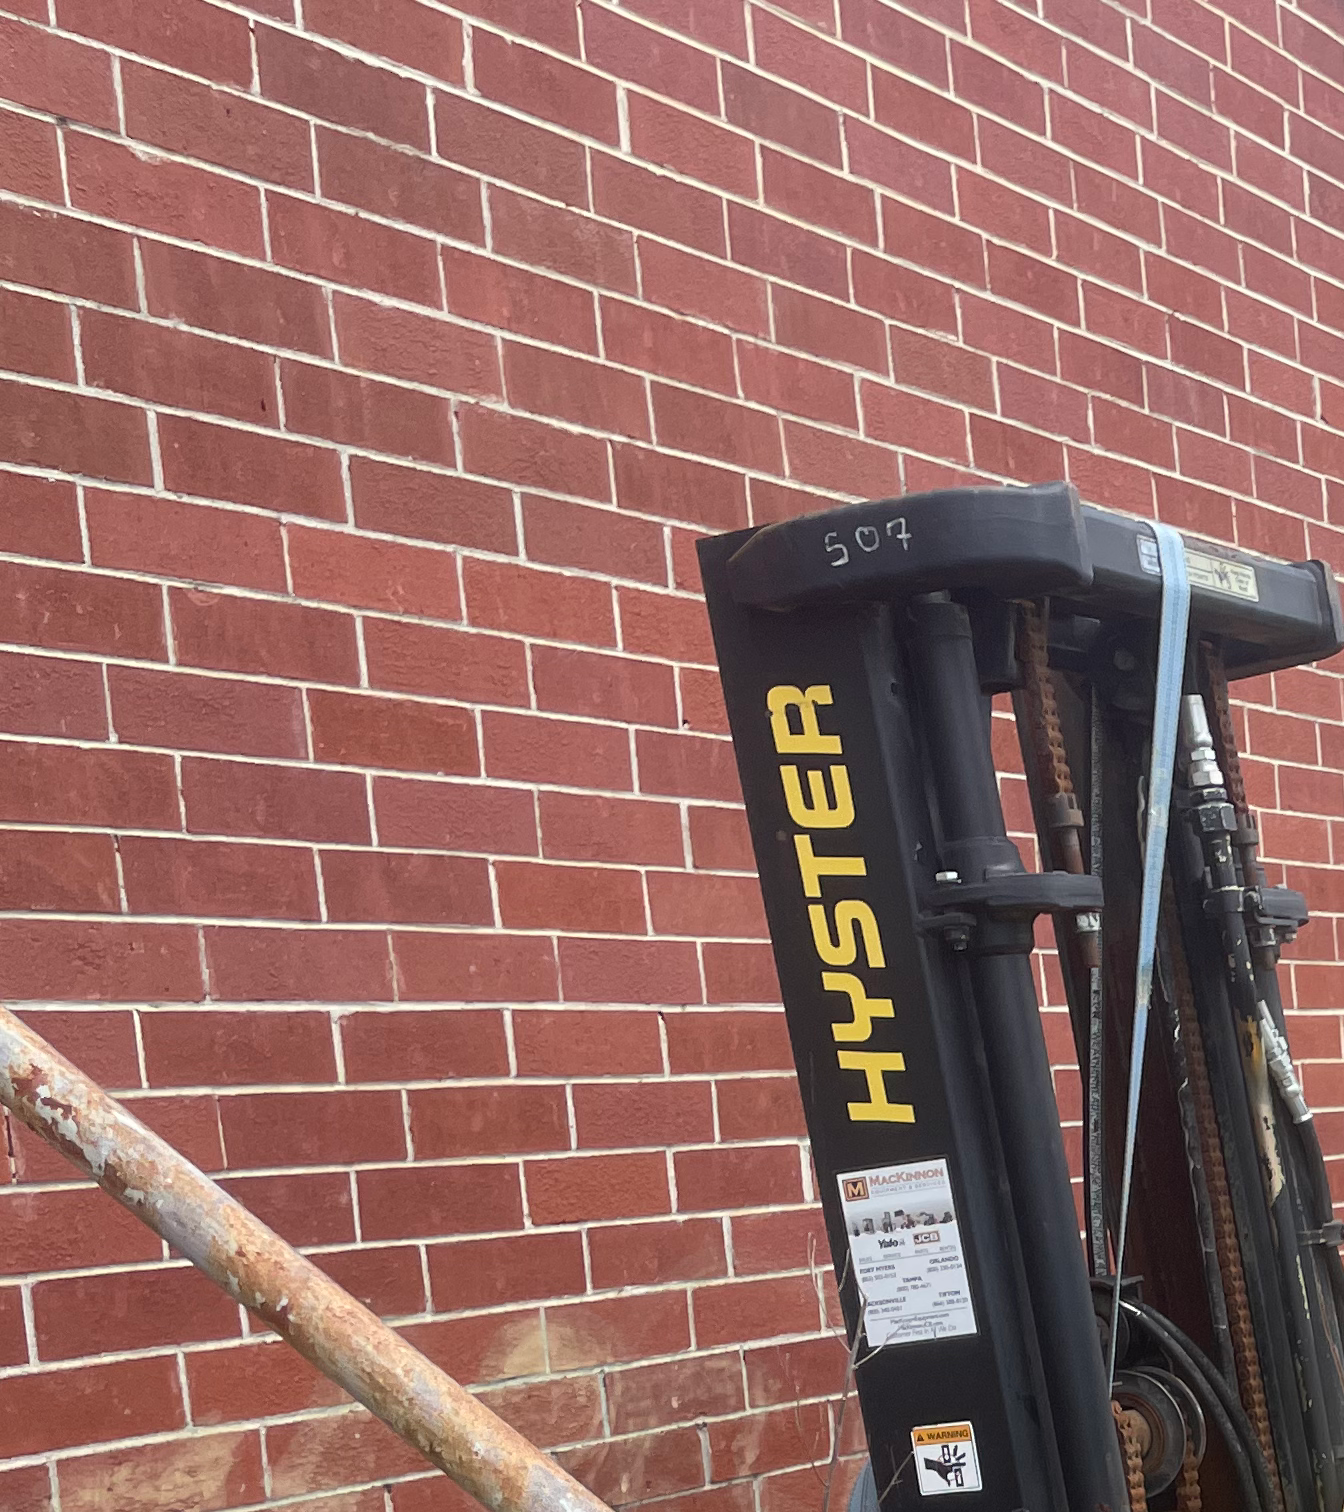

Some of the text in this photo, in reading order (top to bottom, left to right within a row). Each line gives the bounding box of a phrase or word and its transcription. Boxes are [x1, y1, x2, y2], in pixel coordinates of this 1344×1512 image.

[823, 517, 913, 567] 507
[766, 684, 916, 1123] HYSTER
[846, 1181, 866, 1198] M
[914, 1232, 940, 1245] JCB
[926, 1429, 969, 1441] WARNING
